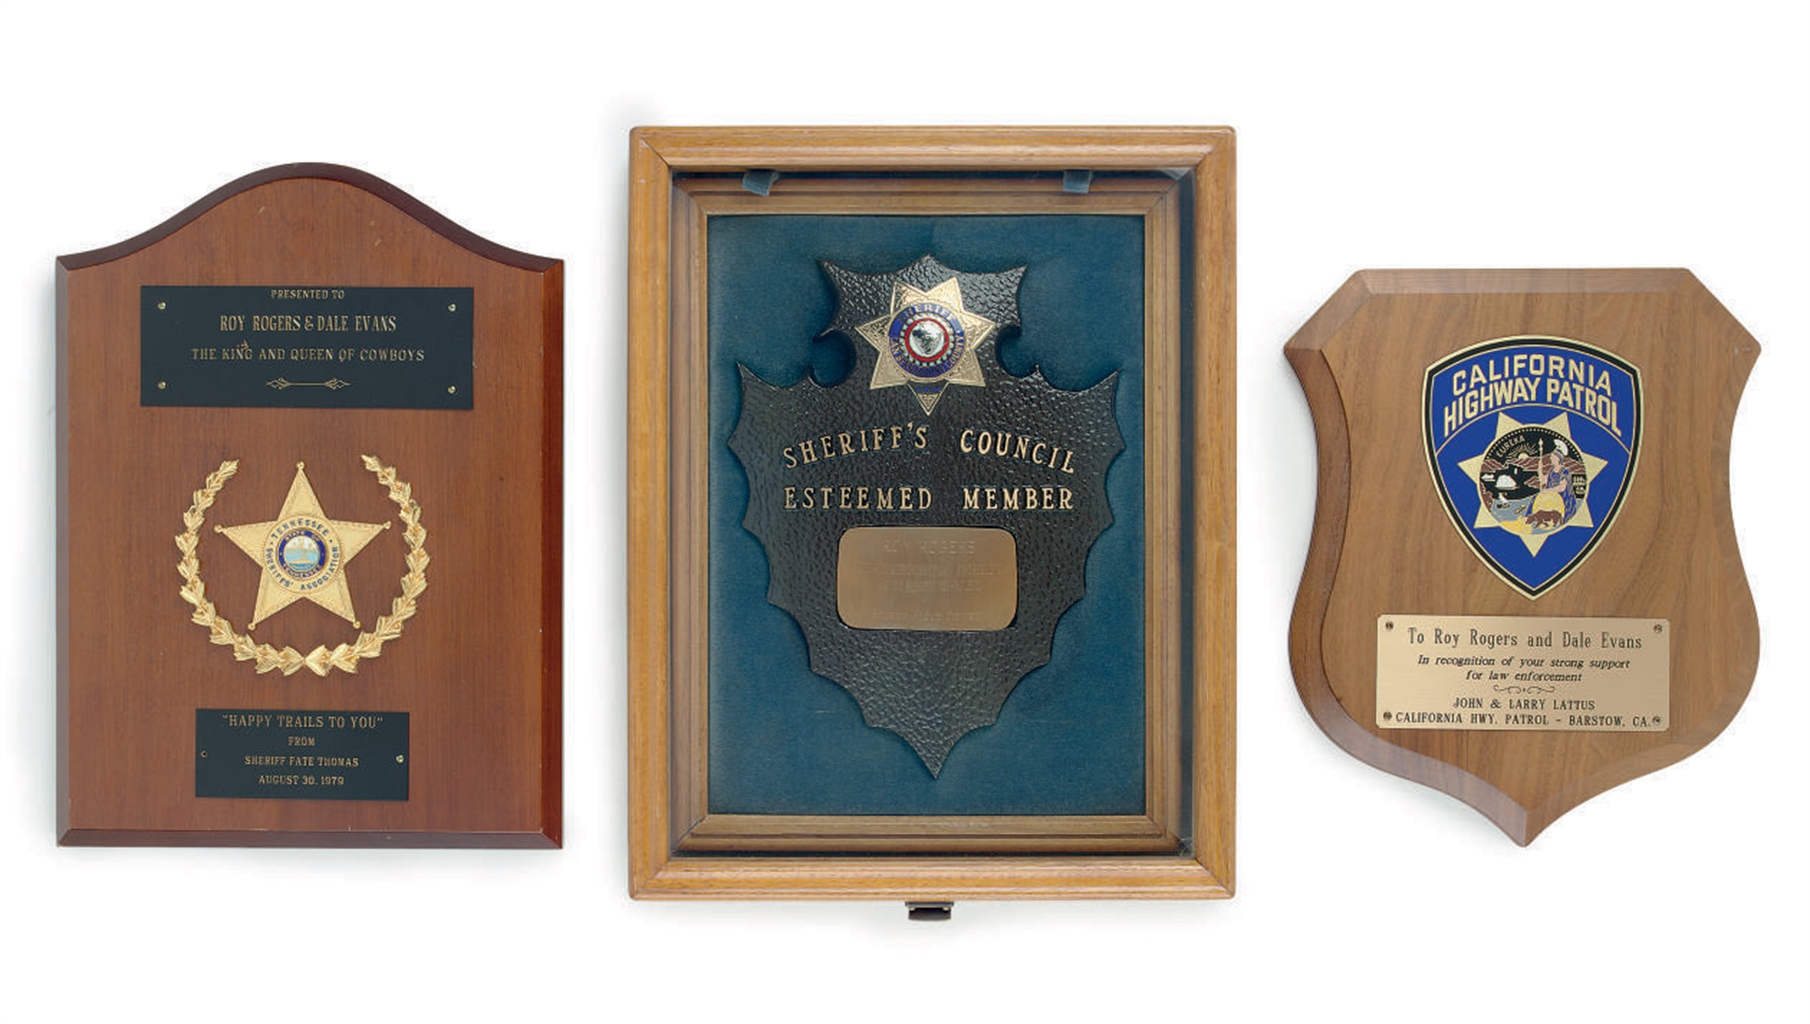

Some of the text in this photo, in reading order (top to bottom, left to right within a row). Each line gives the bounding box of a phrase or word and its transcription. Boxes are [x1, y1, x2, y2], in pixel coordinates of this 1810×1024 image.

[271, 289, 345, 300] PRESENTED TO
[220, 315, 396, 332] ROY ROGERS & DALE EVANS
[191, 348, 216, 360] THE
[222, 348, 252, 360] KING
[260, 348, 286, 360] AND
[290, 348, 334, 361] QUEEN
[360, 349, 424, 362] COWBOYS
[1453, 354, 1612, 396] CALIFORNIA
[1444, 377, 1622, 438] HIGHWAY PATROL
[783, 422, 1074, 474] SHERIFF'S COUNCIL
[784, 487, 1074, 510] ESTEEMED MEMBER
[271, 518, 330, 540] TENNESSEE
[300, 546, 340, 590] ASSOCIATION
[1408, 628, 1642, 650] To Roy Rogers and Dale Evans
[1418, 654, 1630, 670] In recognition of your strong support
[1466, 670, 1583, 682] for law enforcement
[1453, 697, 1596, 711] JOHN & LARRY LATTUS
[222, 714, 384, 729] "HAPPY TRAILS TO YOU"
[1396, 712, 1462, 724] CALIFORNIA
[1505, 714, 1549, 725] PATROL
[288, 736, 316, 746] FROM
[244, 756, 359, 768] SHERIFF FATE THOMAS
[258, 775, 300, 785] AUGUST
[321, 776, 344, 786] 1979
